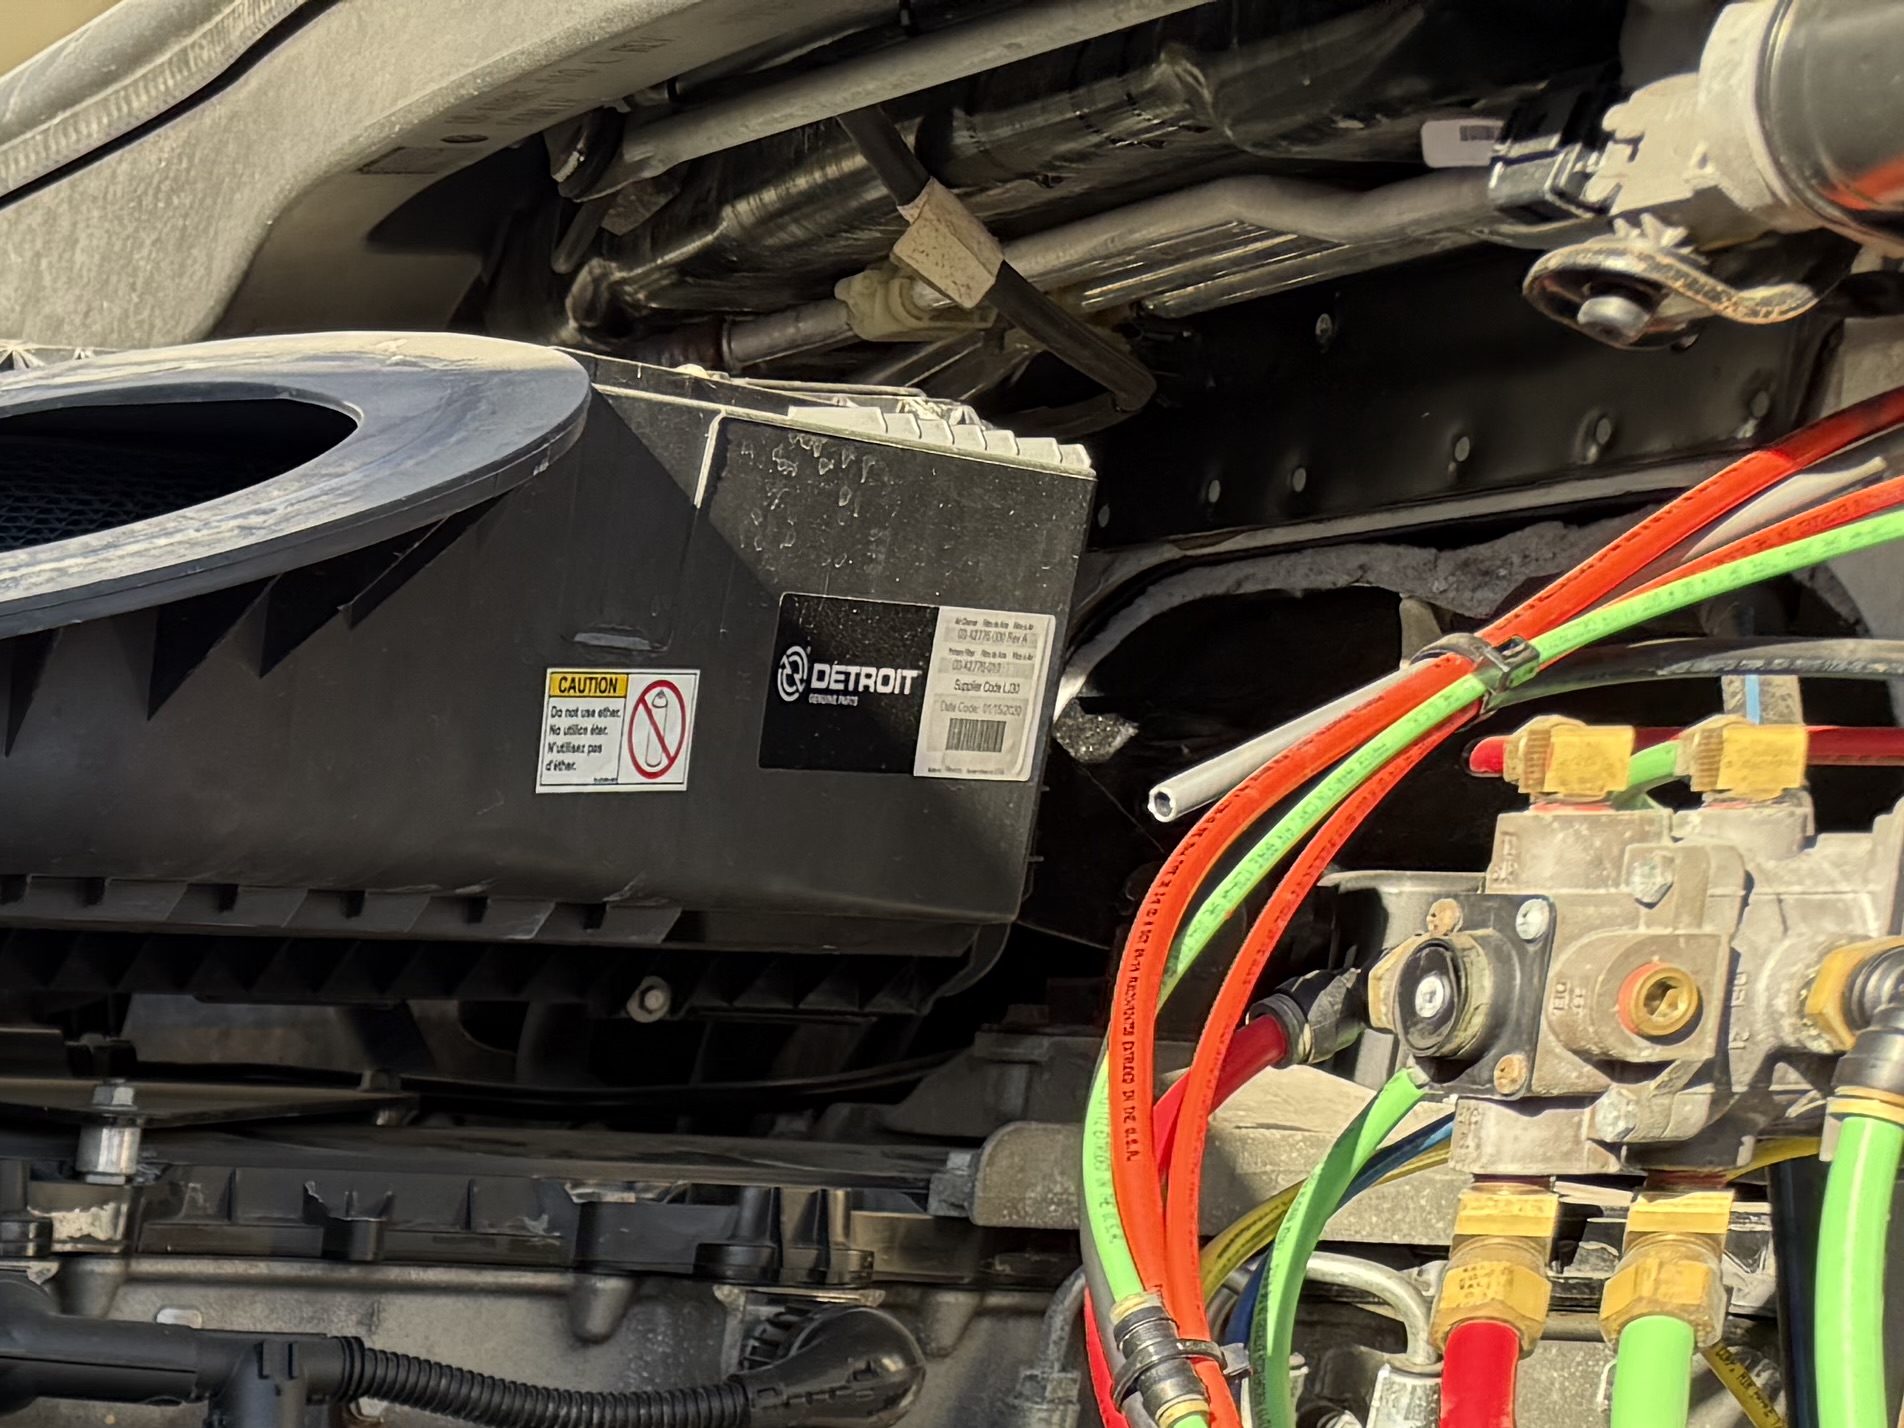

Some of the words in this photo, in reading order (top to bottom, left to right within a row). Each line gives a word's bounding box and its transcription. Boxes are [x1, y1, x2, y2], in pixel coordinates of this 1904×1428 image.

[558, 676, 618, 694] CAUTION
[811, 663, 919, 695] DETROIT
[955, 679, 981, 691] Supplier
[984, 682, 1001, 692] Code
[550, 706, 563, 718] Do
[565, 707, 578, 718] not
[581, 708, 595, 718] use
[598, 707, 621, 718] ether.
[941, 701, 955, 712] Date
[549, 725, 561, 735] No
[564, 725, 587, 735] utilice
[588, 744, 603, 756] pas
